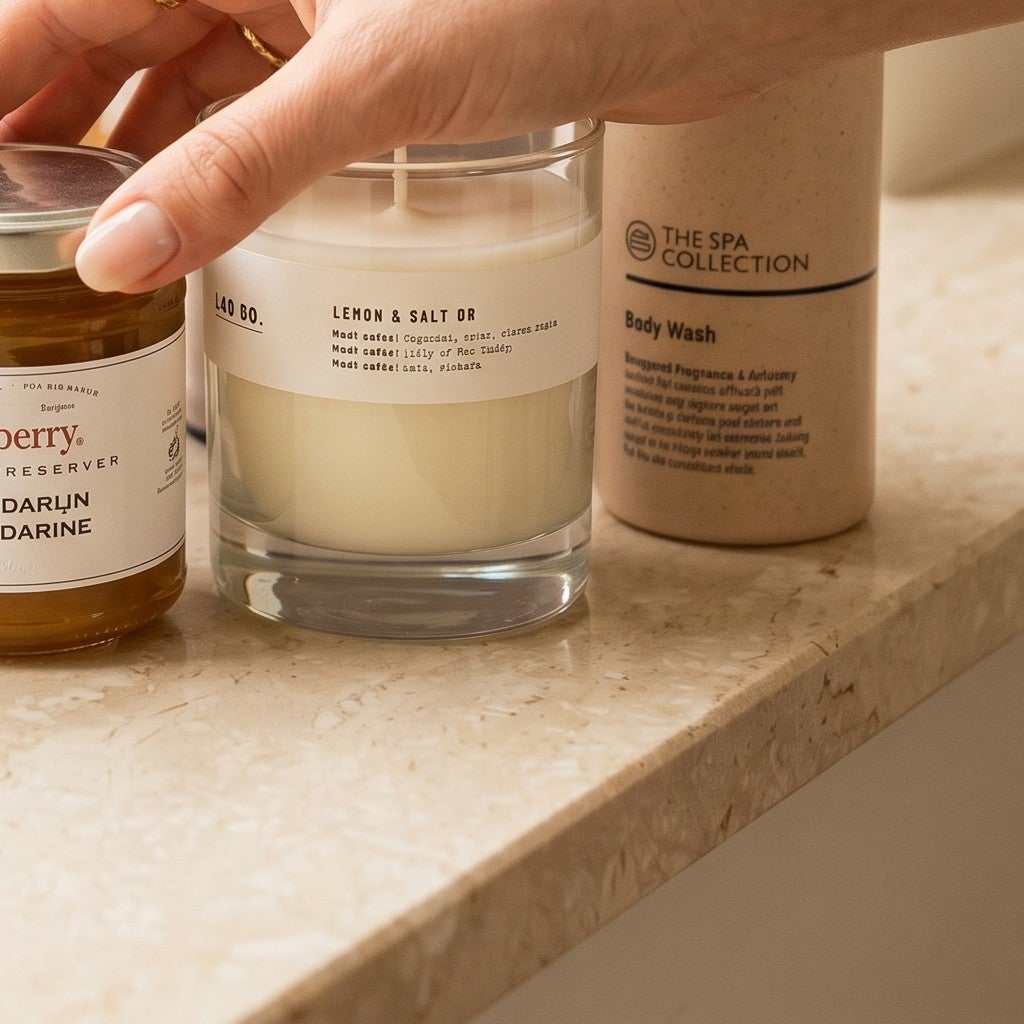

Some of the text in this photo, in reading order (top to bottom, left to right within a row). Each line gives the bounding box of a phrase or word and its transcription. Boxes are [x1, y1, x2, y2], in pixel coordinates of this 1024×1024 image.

[662, 226, 750, 252] THE SPA
[661, 248, 810, 274] COLLECTION
[332, 305, 383, 323] LEMON
[391, 310, 401, 323] &
[409, 309, 448, 323] SALT
[625, 310, 717, 344] Body Wash
[440, 347, 451, 357] of
